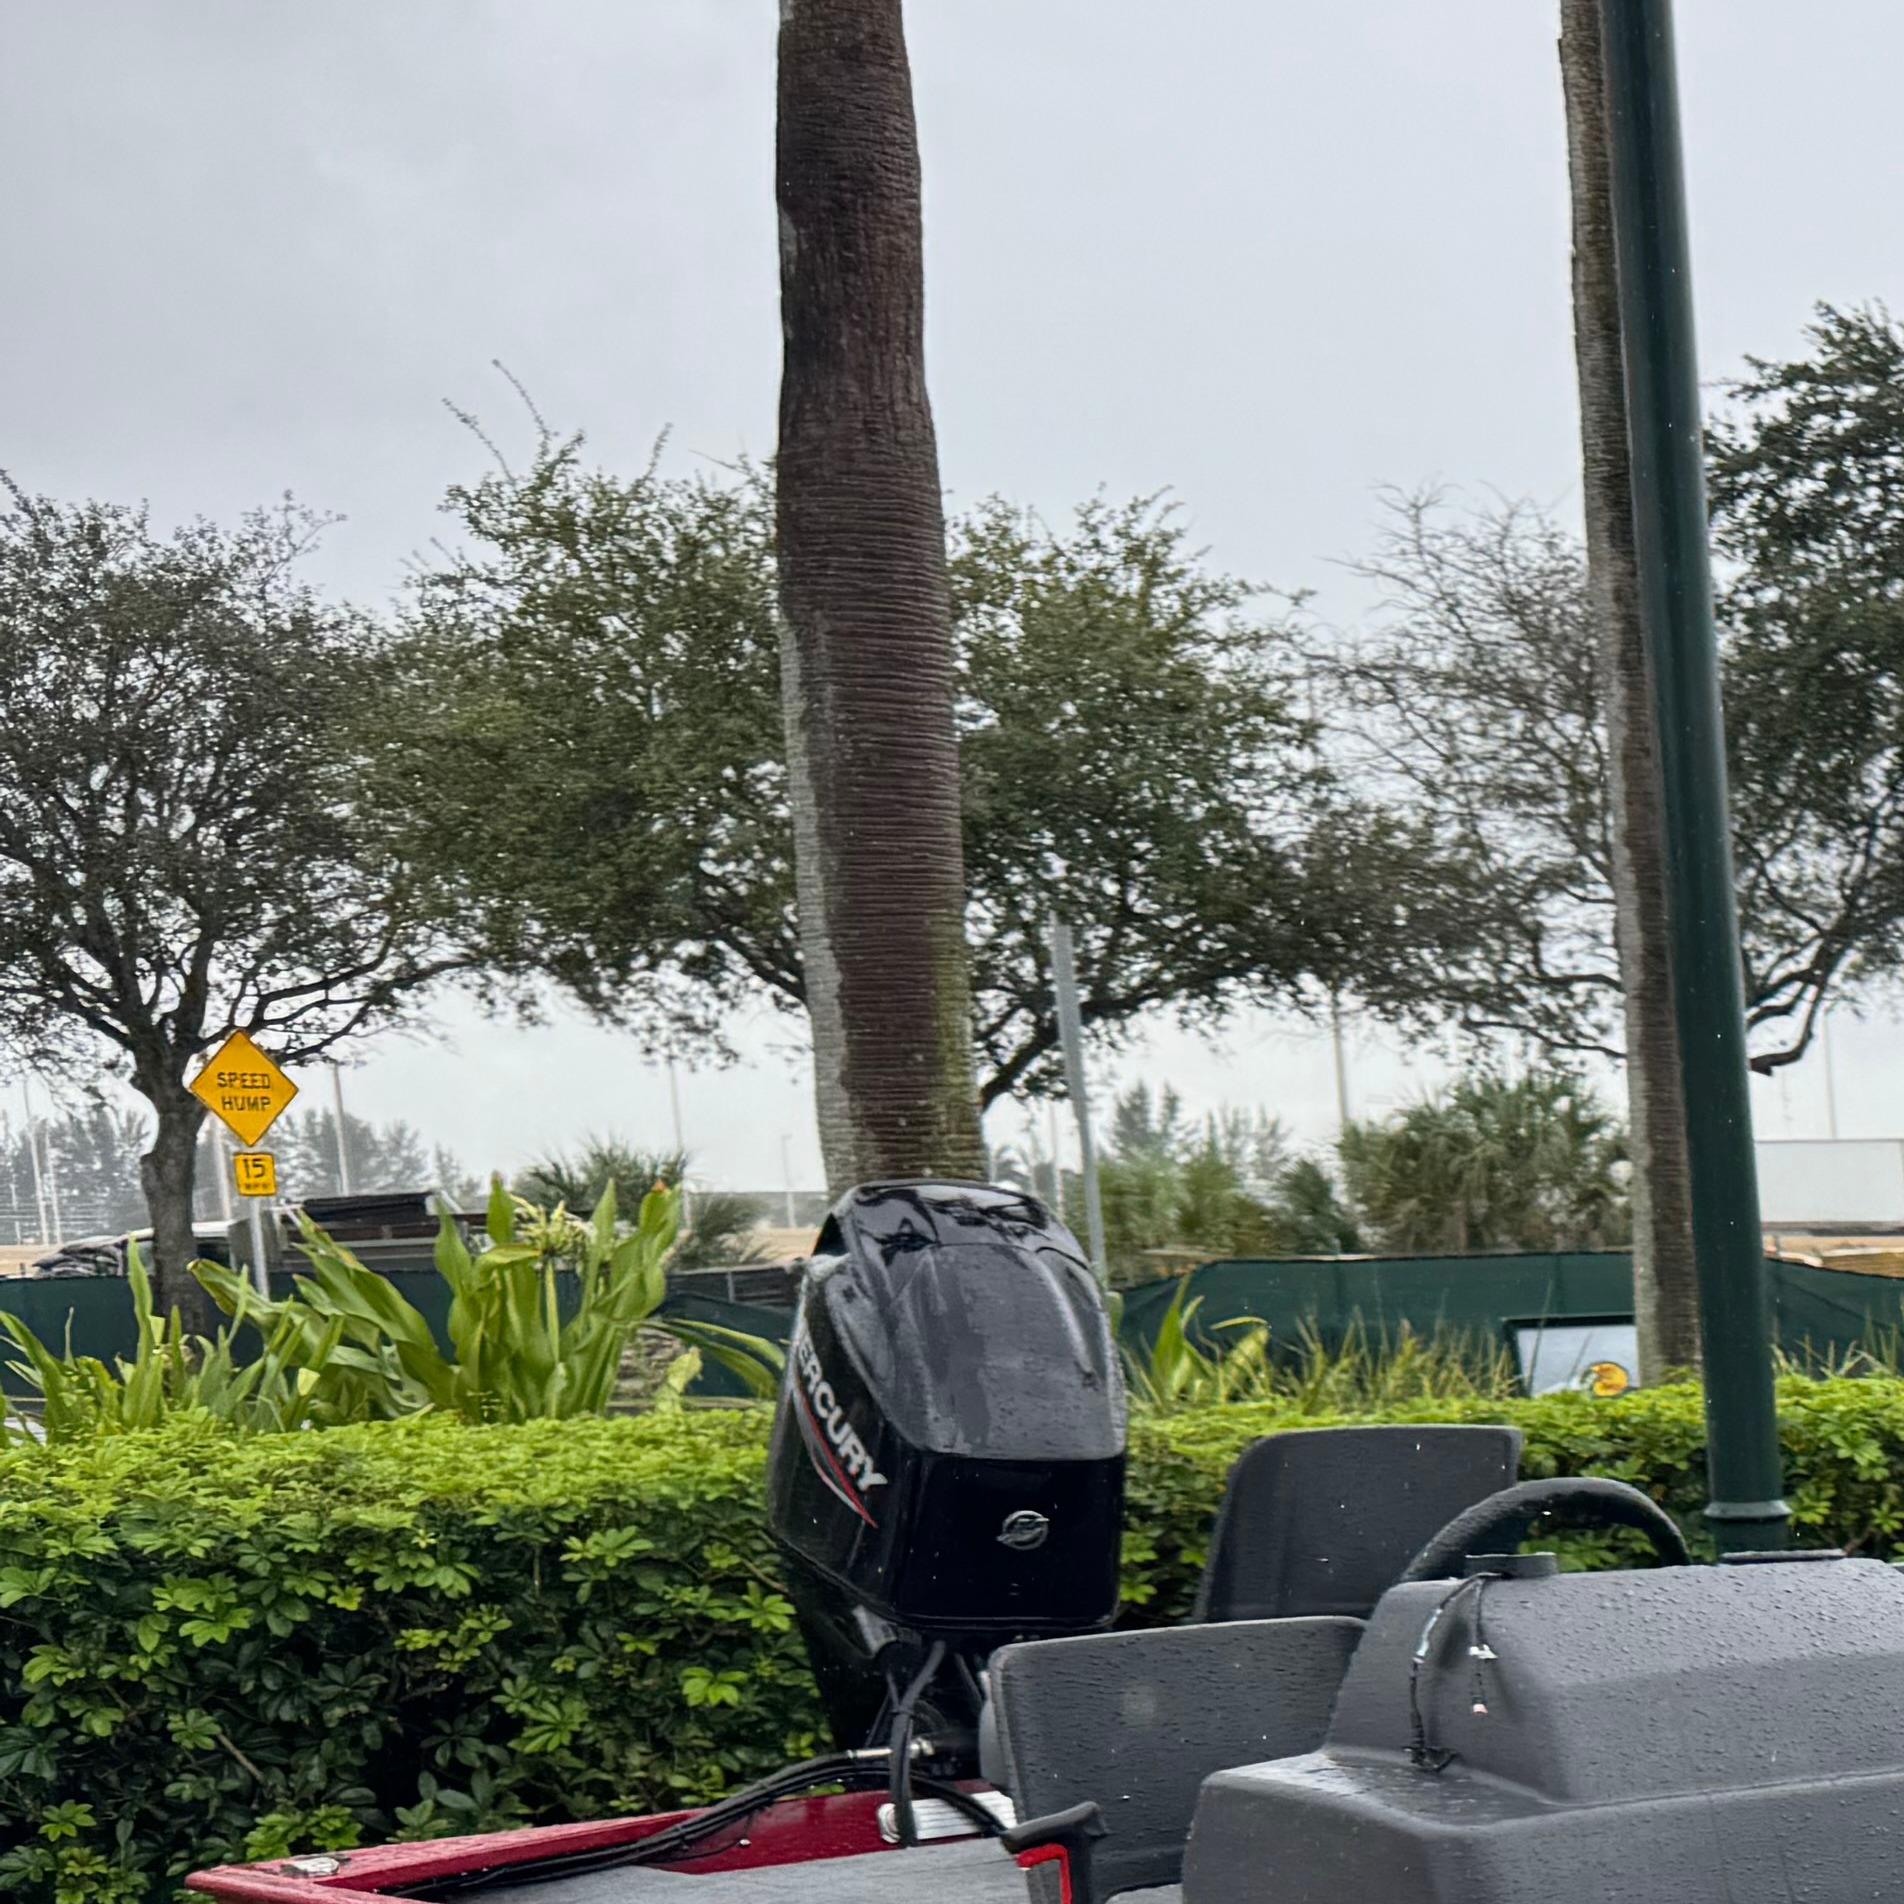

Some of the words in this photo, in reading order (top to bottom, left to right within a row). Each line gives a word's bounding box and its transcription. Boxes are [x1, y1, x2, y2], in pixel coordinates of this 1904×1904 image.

[216, 1071, 271, 1089] SPEED
[220, 1096, 272, 1112] HUMP
[243, 1158, 267, 1179] 15
[798, 1320, 888, 1492] ERCURY
